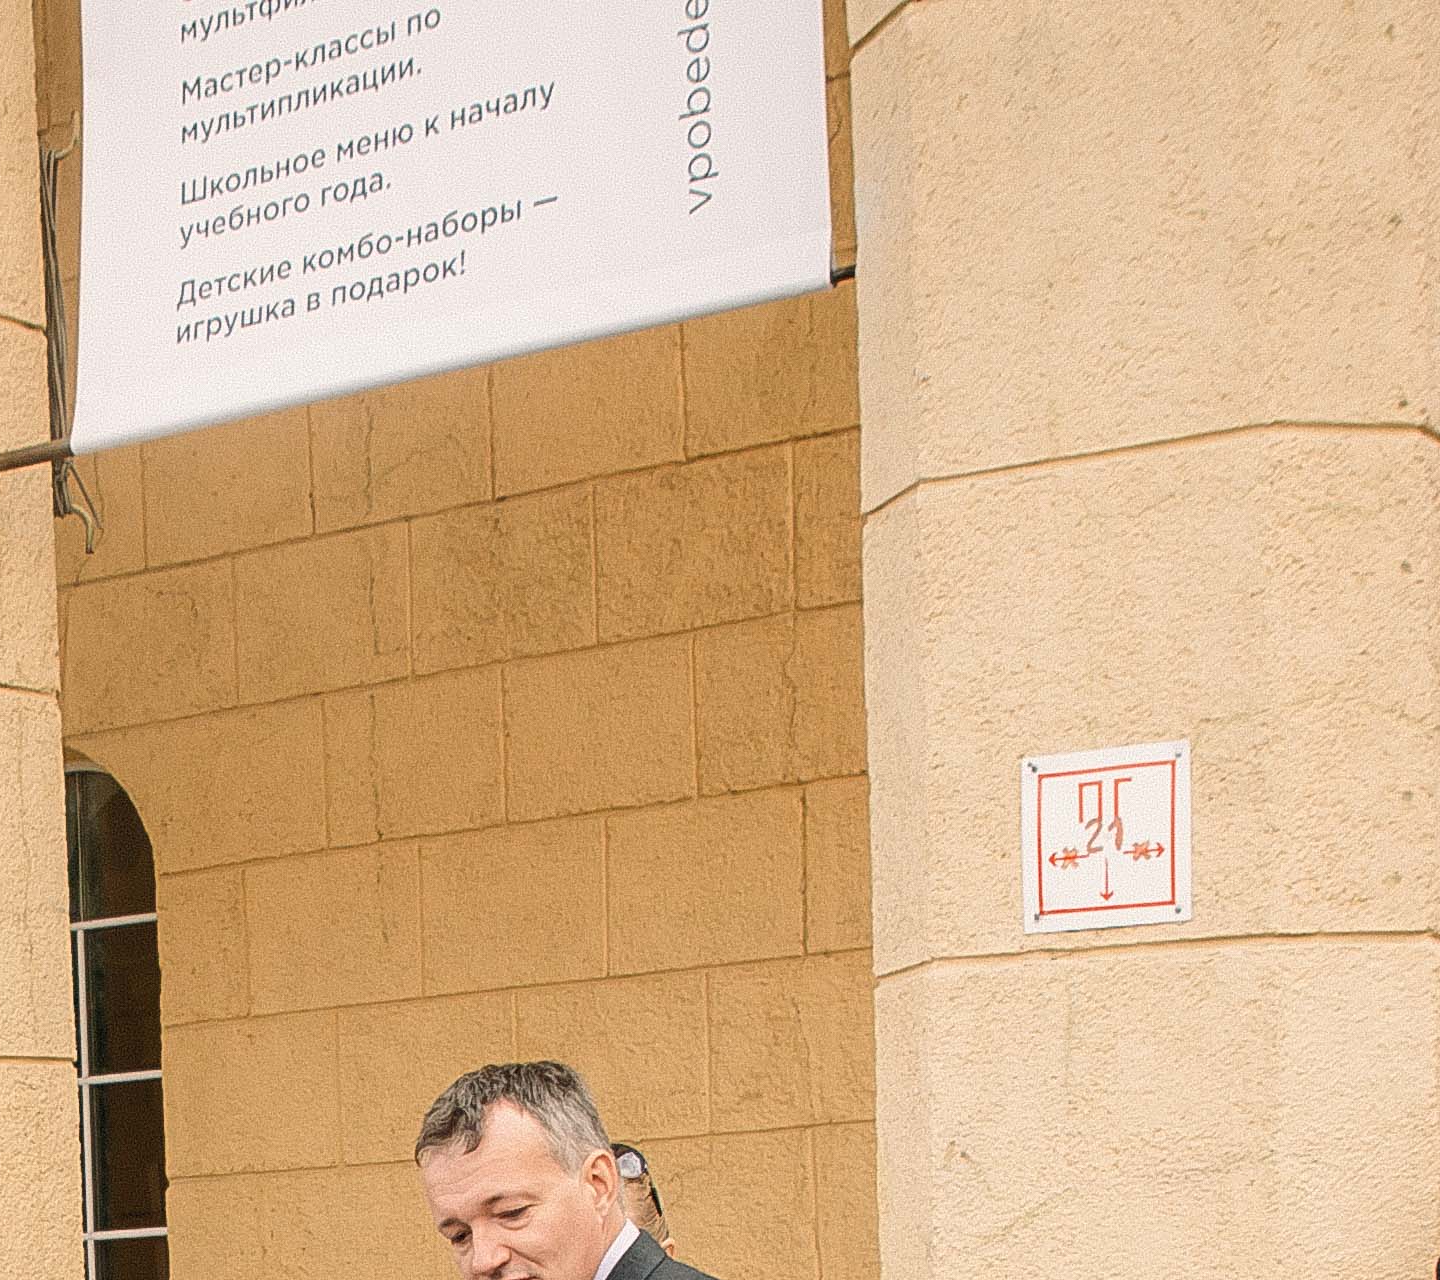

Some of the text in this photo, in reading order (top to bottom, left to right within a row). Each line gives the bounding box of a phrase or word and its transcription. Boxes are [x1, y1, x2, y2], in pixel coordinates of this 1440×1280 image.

[181, 0, 315, 43] мультфи
[182, 8, 441, 104] Мастер-классы по
[180, 81, 557, 205] Школьное меню к началу
[181, 57, 421, 144] мультипликации.
[176, 257, 292, 312] Детские
[302, 202, 523, 276] комбо-наборы
[178, 173, 391, 249] учебного года.
[175, 251, 467, 345] игрушка в подарок!
